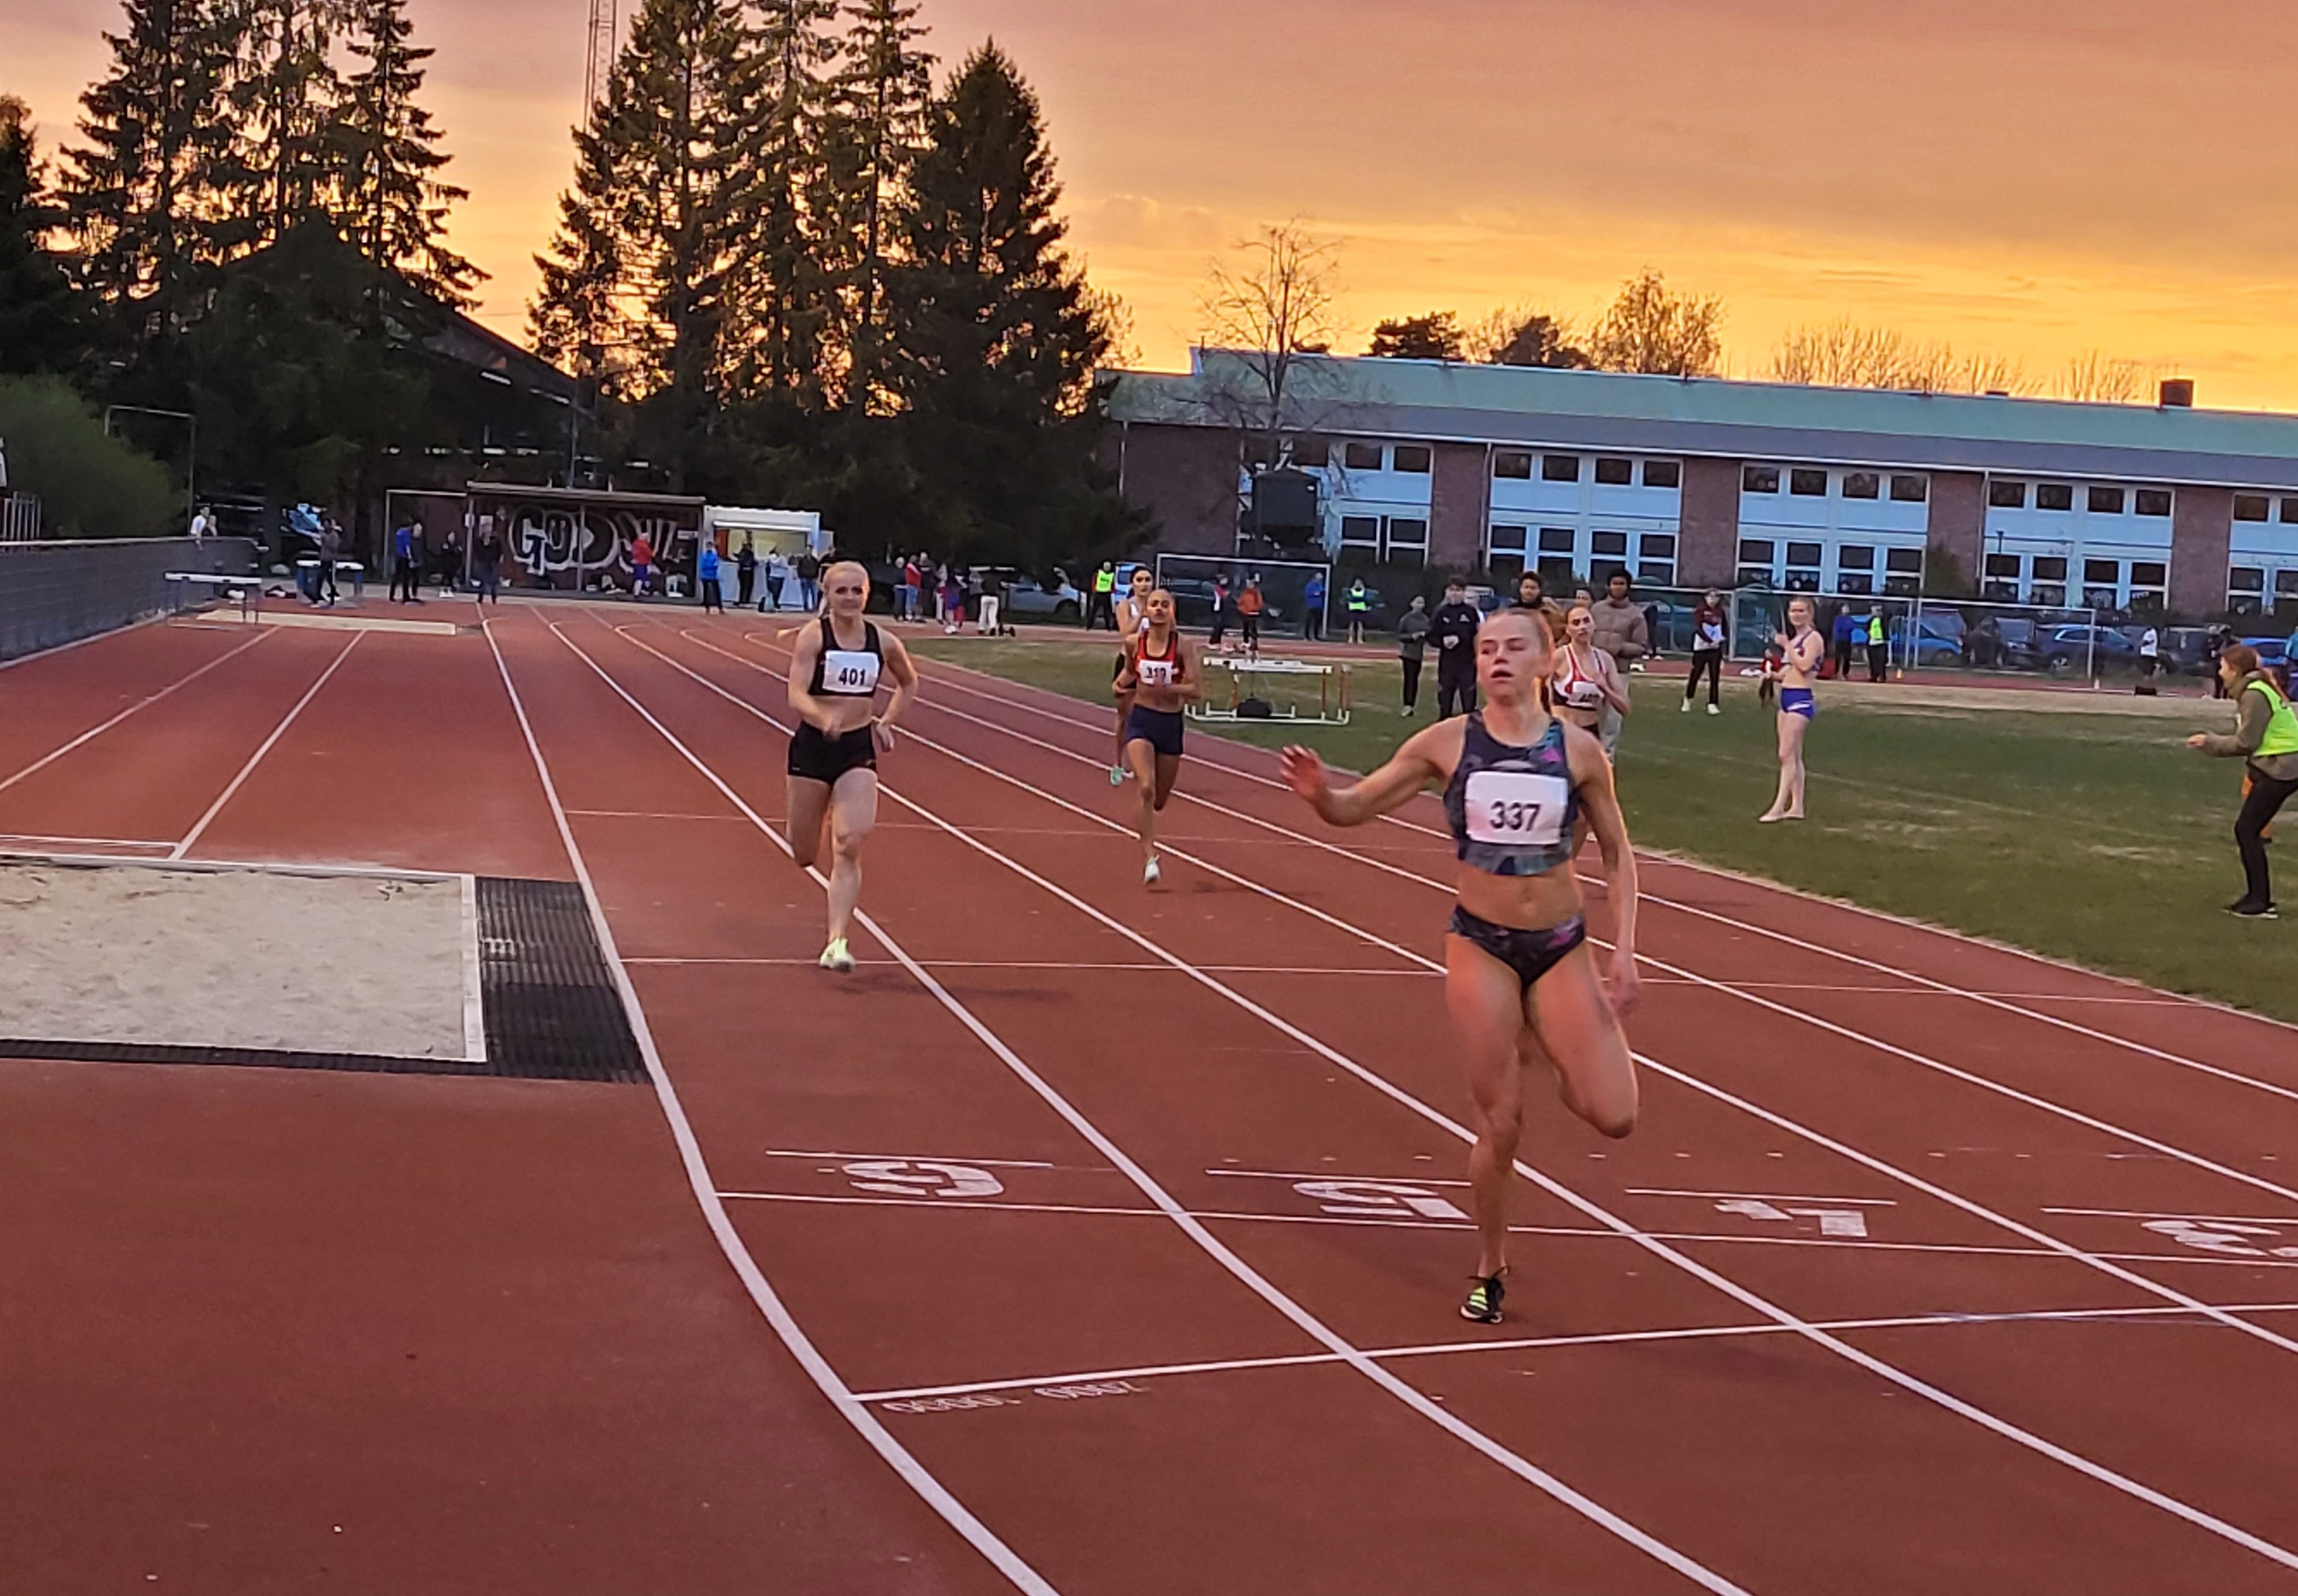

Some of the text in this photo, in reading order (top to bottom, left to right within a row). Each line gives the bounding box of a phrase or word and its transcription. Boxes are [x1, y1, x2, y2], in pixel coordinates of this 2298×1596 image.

[838, 667, 866, 685] 401
[1489, 800, 1541, 832] 337
[1292, 1182, 1472, 1219] 5
[1714, 1200, 1867, 1237] 4
